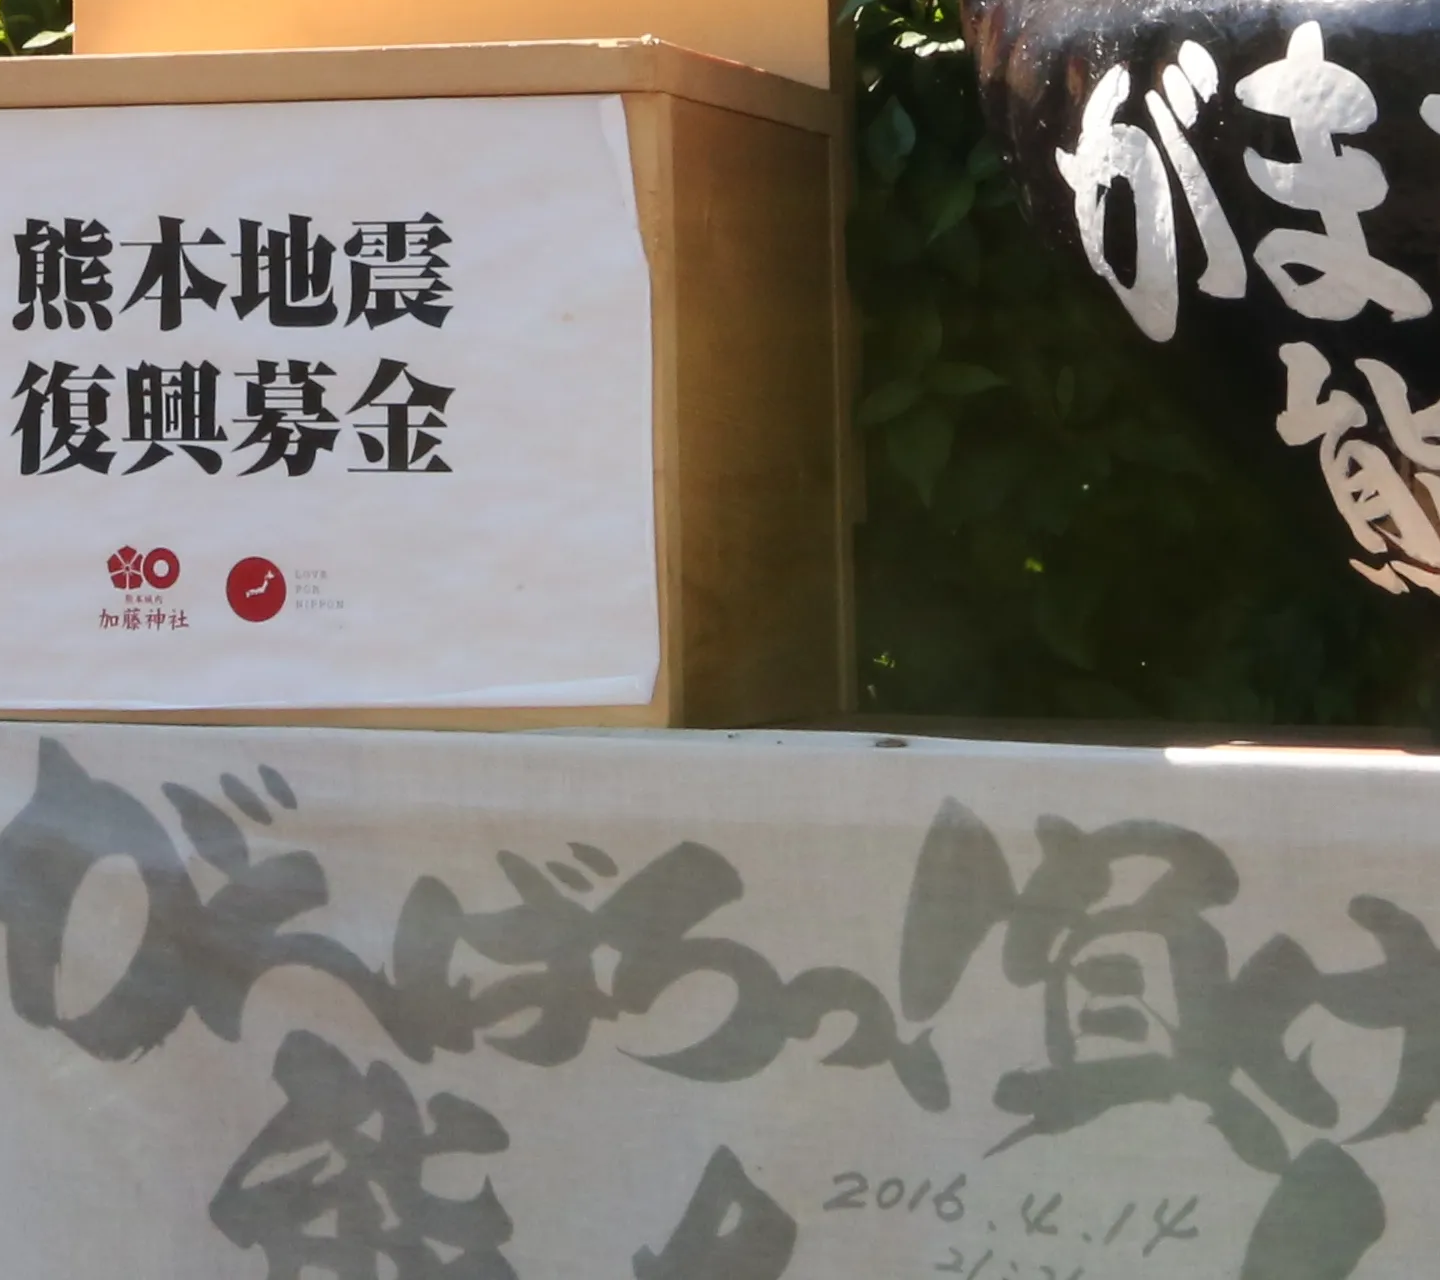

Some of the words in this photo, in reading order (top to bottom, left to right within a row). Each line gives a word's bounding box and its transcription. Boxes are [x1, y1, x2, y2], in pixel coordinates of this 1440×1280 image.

[12, 211, 455, 332] 熊本地震
[11, 358, 456, 477] 復興募金
[99, 607, 189, 631] 加藤神社
